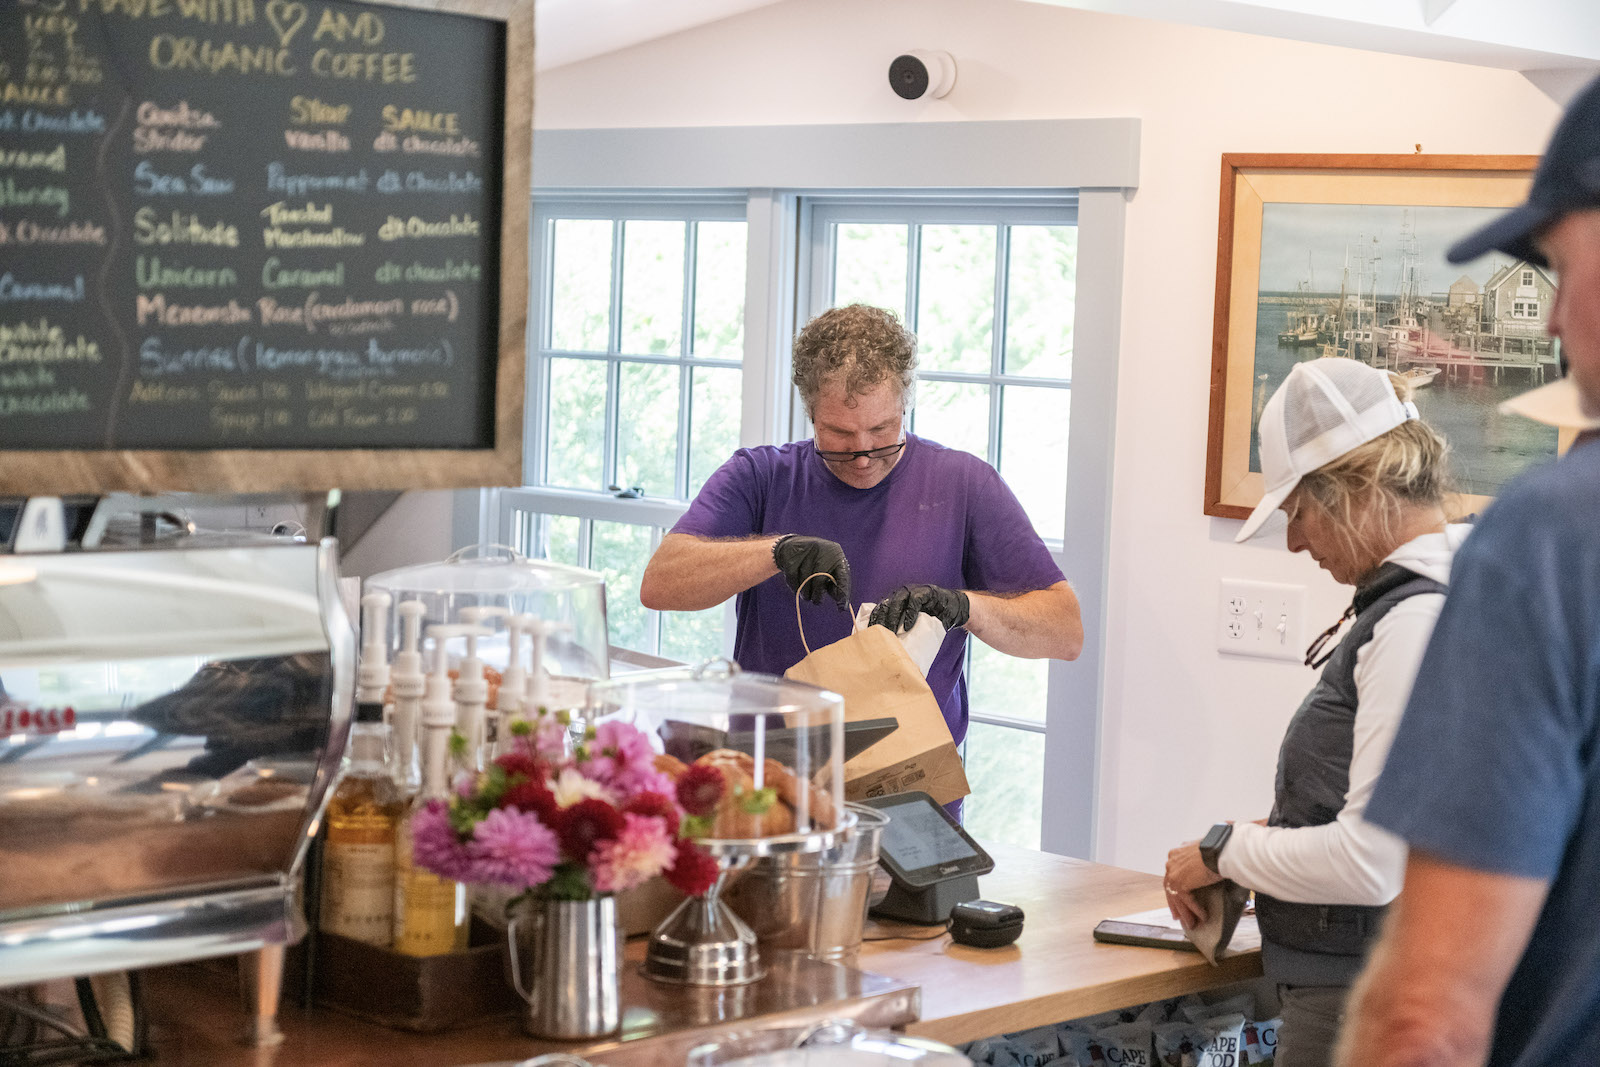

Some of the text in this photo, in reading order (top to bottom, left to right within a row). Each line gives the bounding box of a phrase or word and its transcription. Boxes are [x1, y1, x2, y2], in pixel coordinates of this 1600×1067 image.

[179, 0, 254, 25] WITH
[313, 9, 386, 45] AND
[149, 33, 417, 84] ORGANIC COFFEE
[0, 82, 68, 106] AUCE
[381, 104, 461, 136] SAUCE
[133, 205, 241, 249] Solitude
[135, 253, 238, 292] Unicorn
[1106, 1047, 1148, 1066] CAPE
